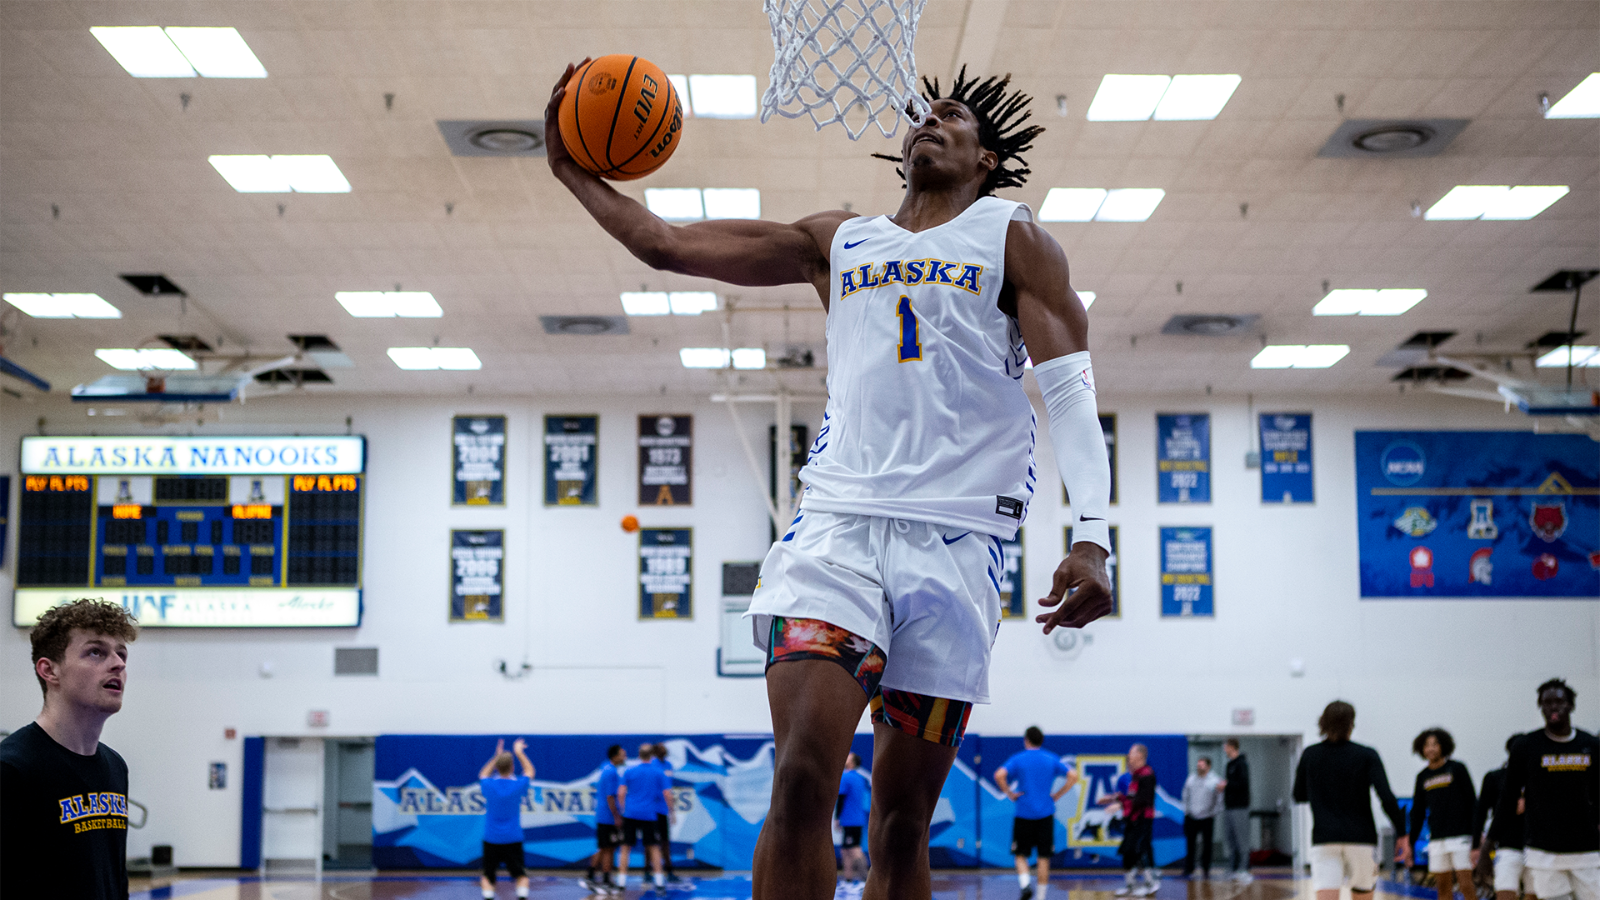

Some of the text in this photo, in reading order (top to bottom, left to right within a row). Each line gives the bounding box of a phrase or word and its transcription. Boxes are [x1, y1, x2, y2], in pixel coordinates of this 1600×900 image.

[840, 258, 984, 301] ALASKA
[896, 294, 923, 364] 1
[43, 446, 339, 467] ALASKA NANOOKS
[58, 791, 129, 824] ALASKA
[400, 788, 537, 815] ALASA
[74, 818, 127, 834] BASKETBALL
